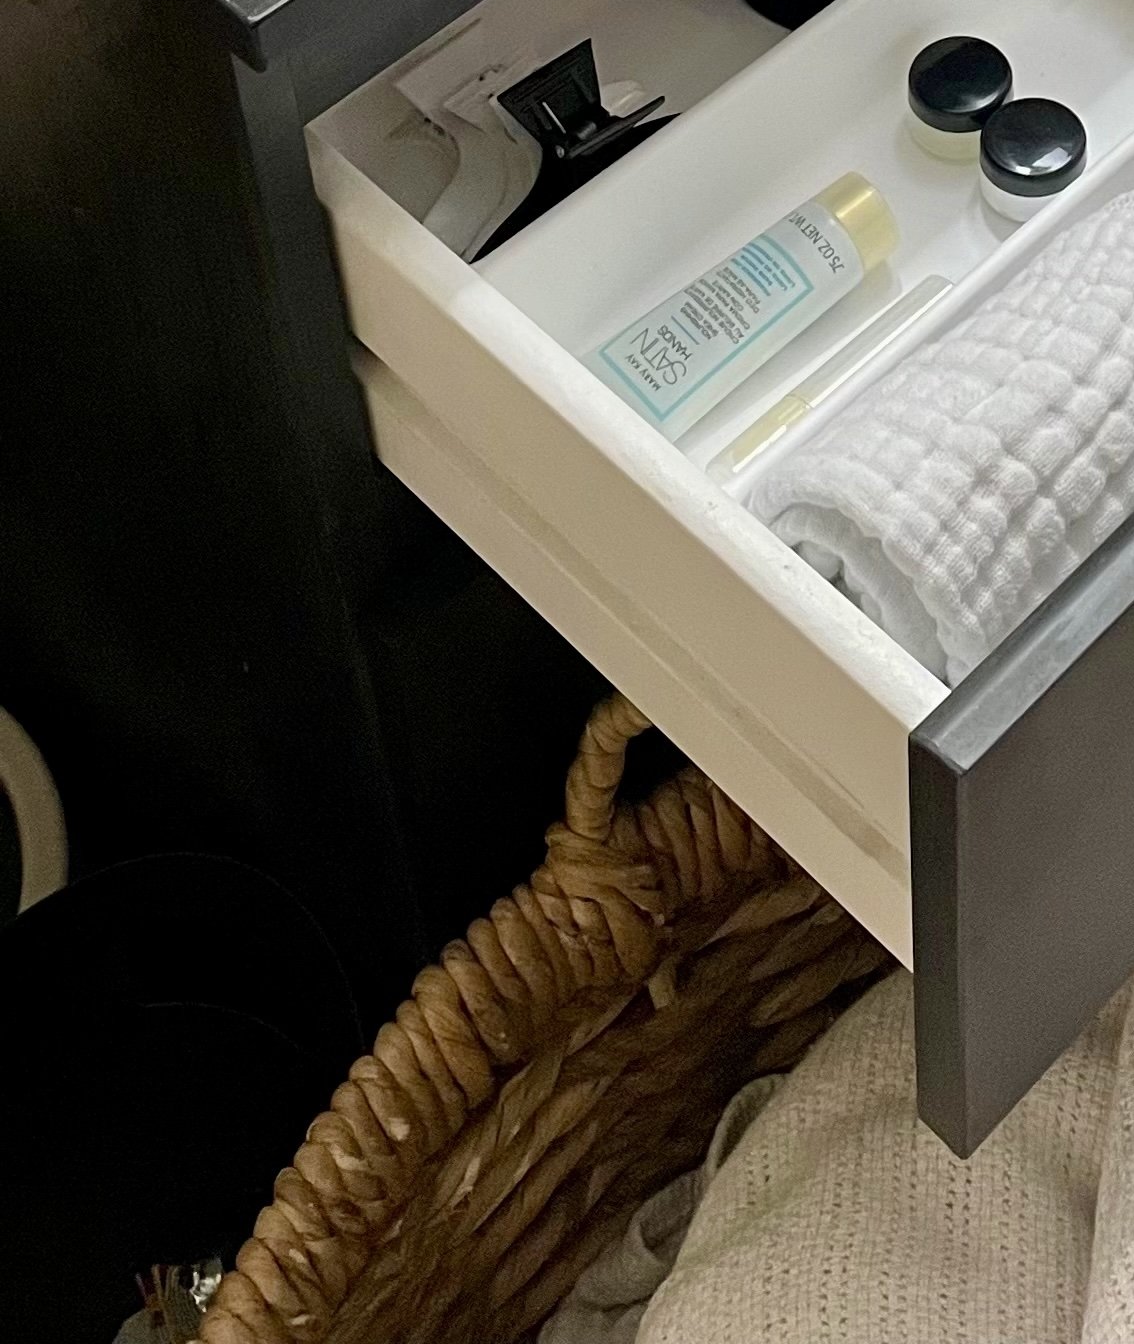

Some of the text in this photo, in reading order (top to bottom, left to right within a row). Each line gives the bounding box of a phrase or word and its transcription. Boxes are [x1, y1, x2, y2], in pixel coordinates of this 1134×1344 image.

[800, 220, 823, 244] NET
[815, 238, 836, 260] OZ
[630, 326, 688, 387] SATIN
[657, 324, 691, 361] HANDS
[625, 353, 660, 391] MARY KAY
